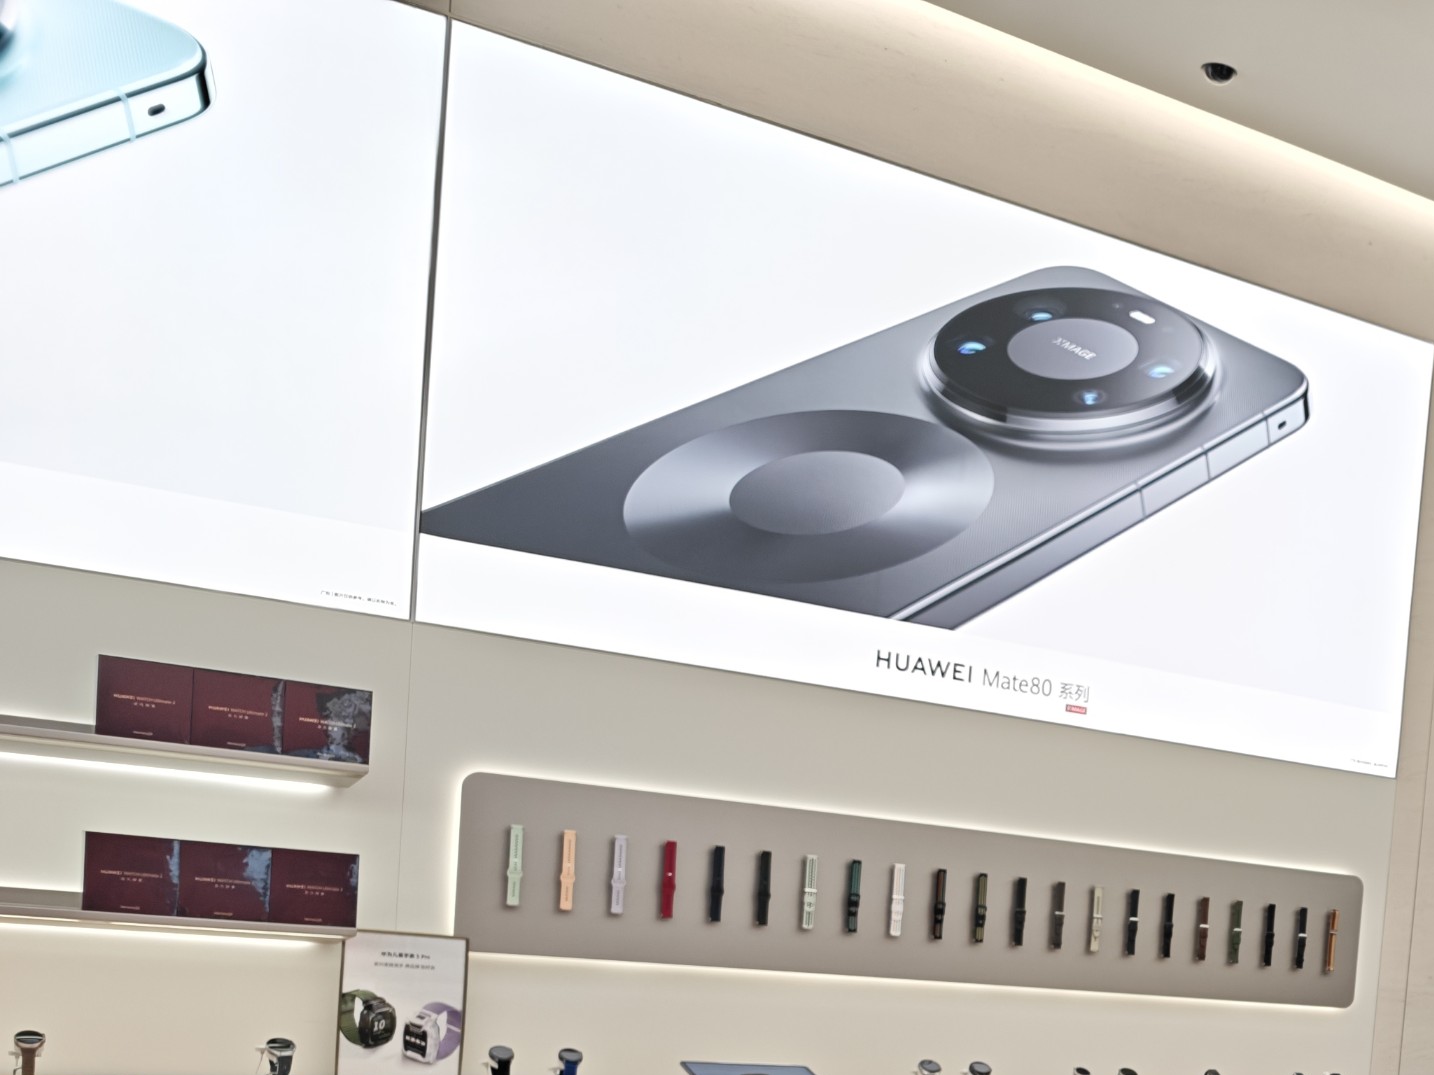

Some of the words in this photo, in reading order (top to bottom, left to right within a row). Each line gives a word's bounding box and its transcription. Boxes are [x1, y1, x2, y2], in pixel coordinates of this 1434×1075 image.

[876, 649, 974, 683] HUAWEI
[982, 668, 1053, 698] Mate80
[1059, 682, 1090, 703] 系列
